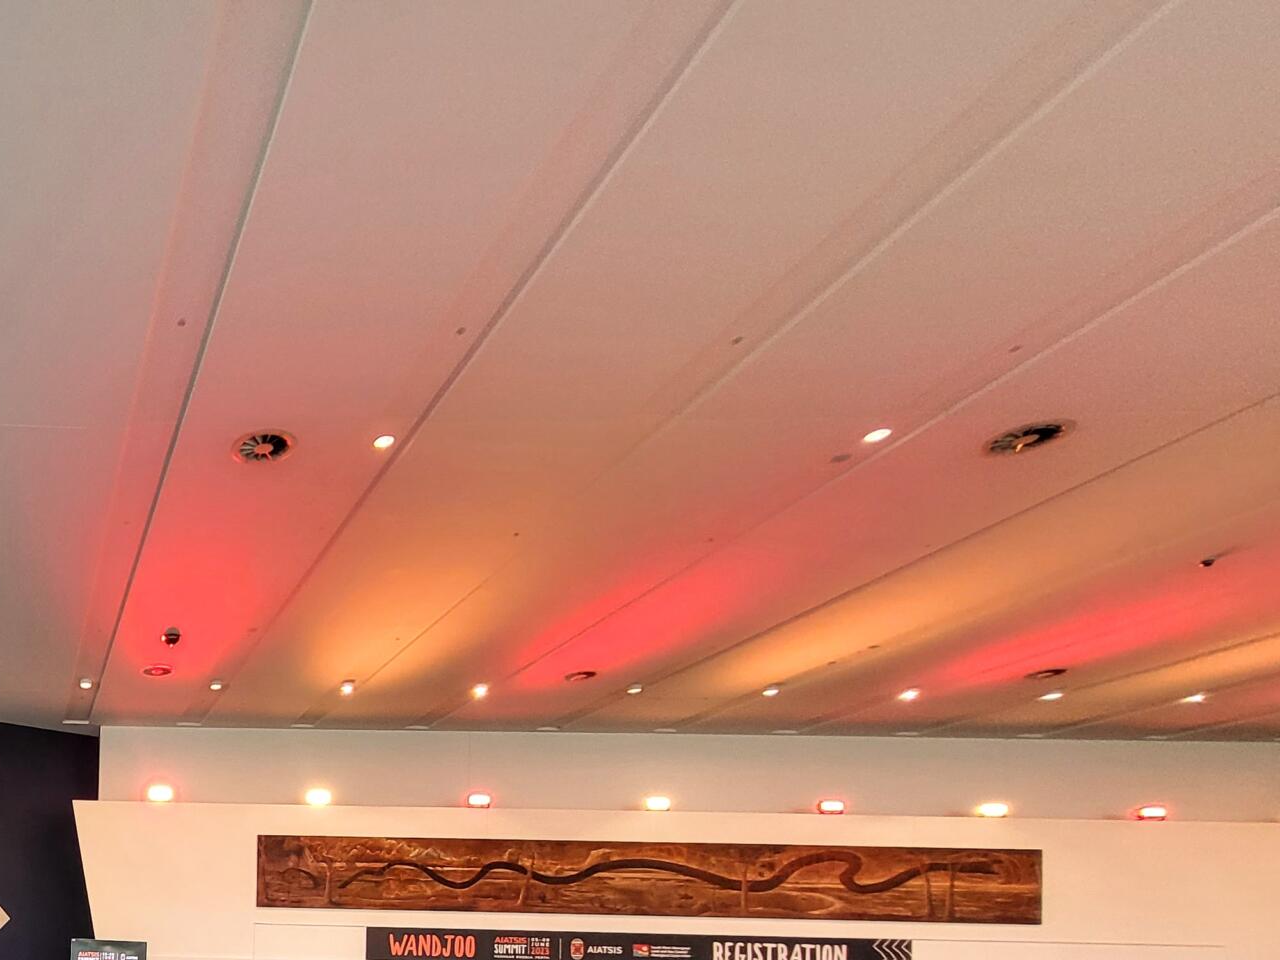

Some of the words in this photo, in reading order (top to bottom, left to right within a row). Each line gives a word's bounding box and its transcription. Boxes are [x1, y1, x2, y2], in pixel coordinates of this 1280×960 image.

[494, 936, 527, 944] AIATSIS
[389, 934, 476, 958] WANDJOO
[493, 943, 527, 955] SUMMIT
[587, 945, 623, 954] AIATSIS
[531, 947, 550, 955] 2023
